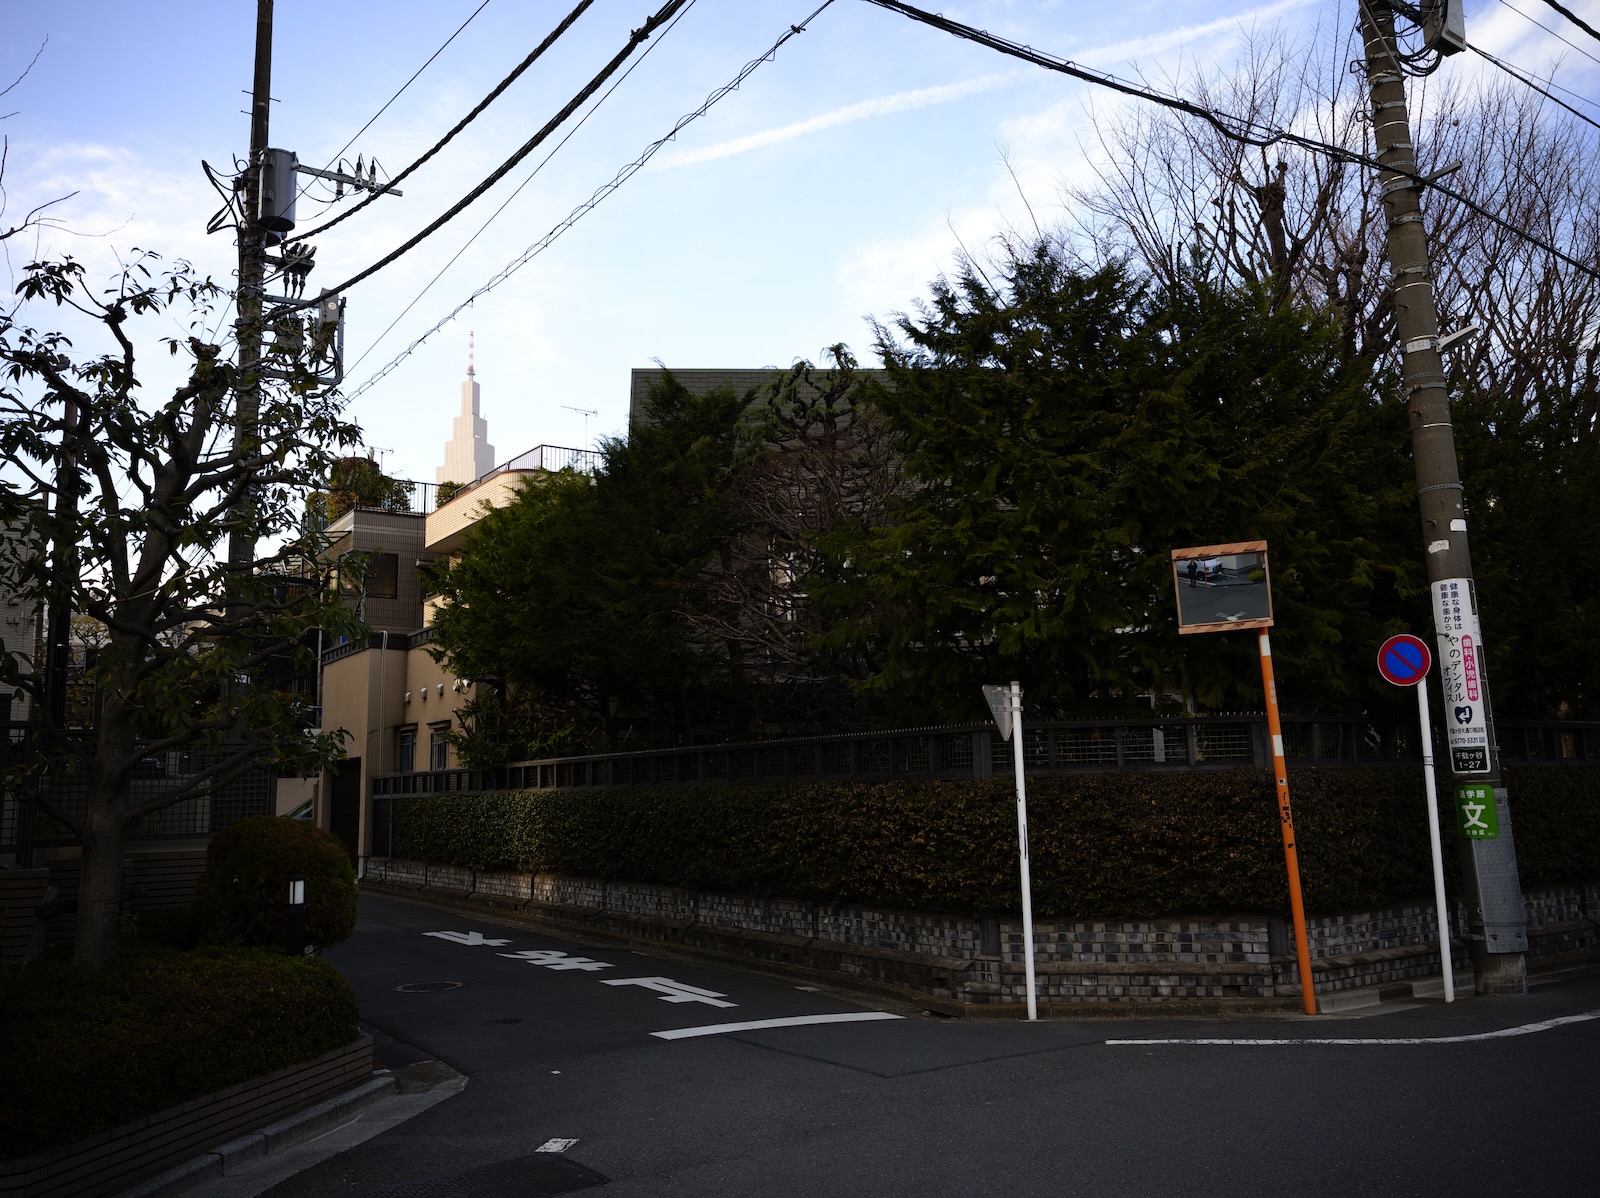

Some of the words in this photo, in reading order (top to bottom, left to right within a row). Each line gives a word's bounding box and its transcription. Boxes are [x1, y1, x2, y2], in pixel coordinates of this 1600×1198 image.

[1439, 583, 1452, 631] 健康な歯から
[1449, 582, 1463, 630] 健康な身体は
[1443, 665, 1455, 703] オフィス
[1448, 636, 1465, 702] やのデンタル
[1458, 760, 1481, 769] 1-27
[1461, 800, 1489, 829] 文
[420, 929, 740, 1009] 止まれ
